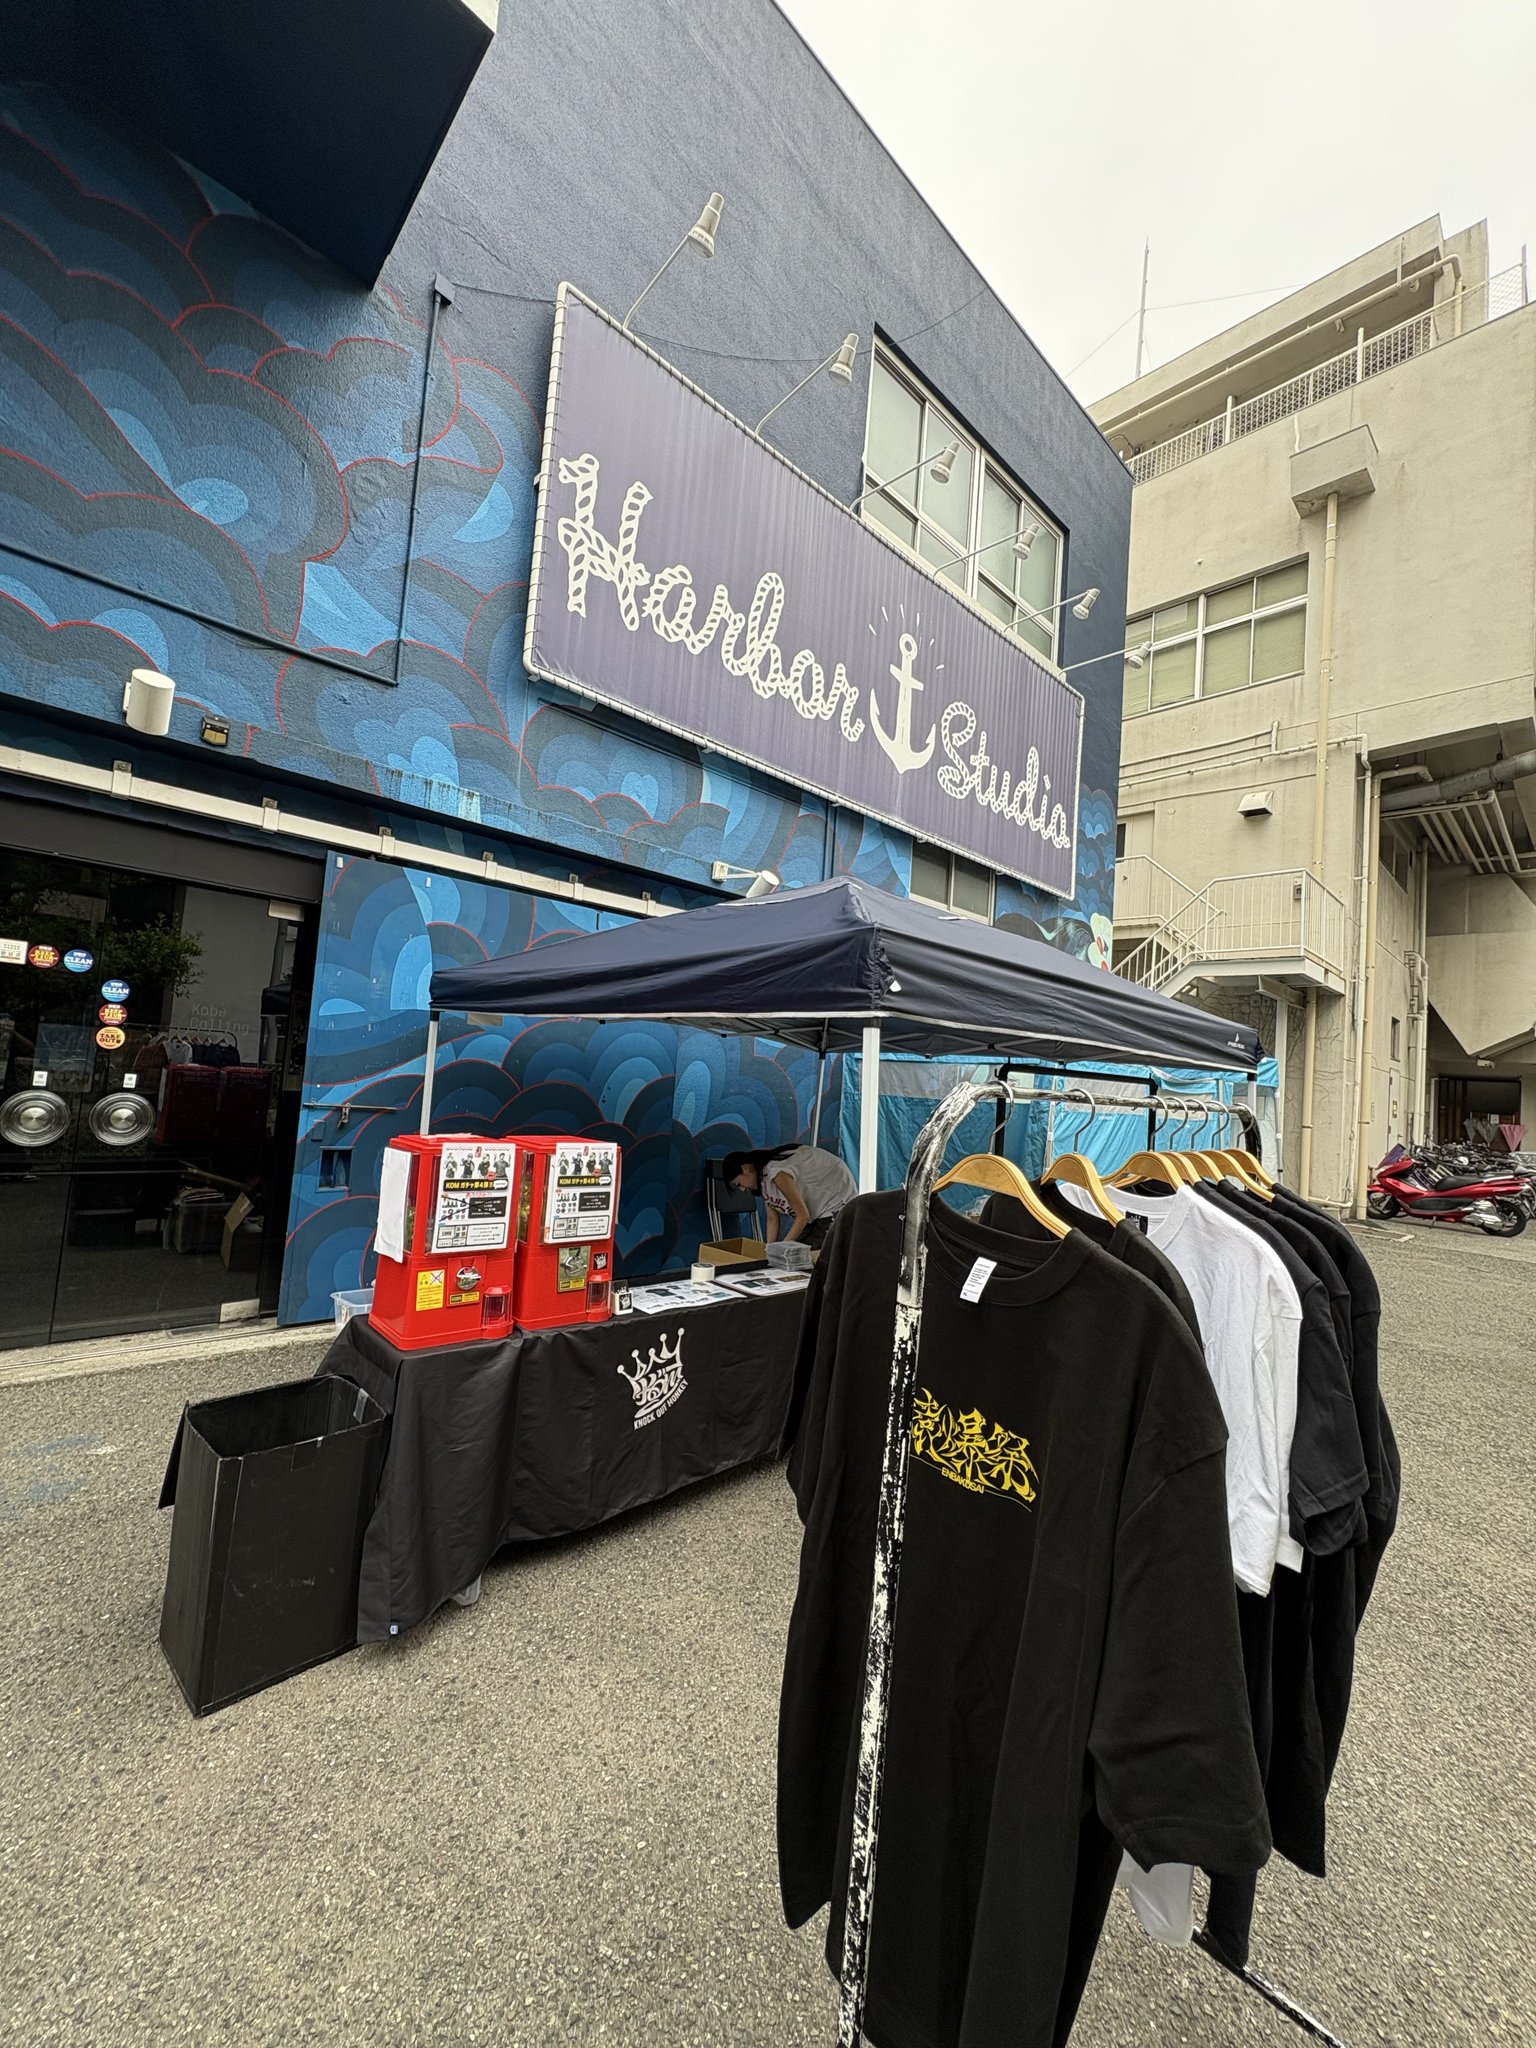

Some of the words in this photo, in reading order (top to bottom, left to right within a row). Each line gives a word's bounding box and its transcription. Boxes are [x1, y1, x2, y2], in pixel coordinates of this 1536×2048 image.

[558, 453, 865, 743] Harbor
[937, 701, 1071, 849] Studio
[64, 956, 93, 965] CLEAN
[102, 986, 129, 995] CLEAN
[192, 1003, 228, 1017] Kobe
[190, 1017, 249, 1036] Calling
[633, 1413, 656, 1430] KNOCK
[656, 1404, 669, 1418] OUT
[667, 1379, 689, 1407] MONKEY
[941, 1466, 985, 1494] ENBAKUSAI
